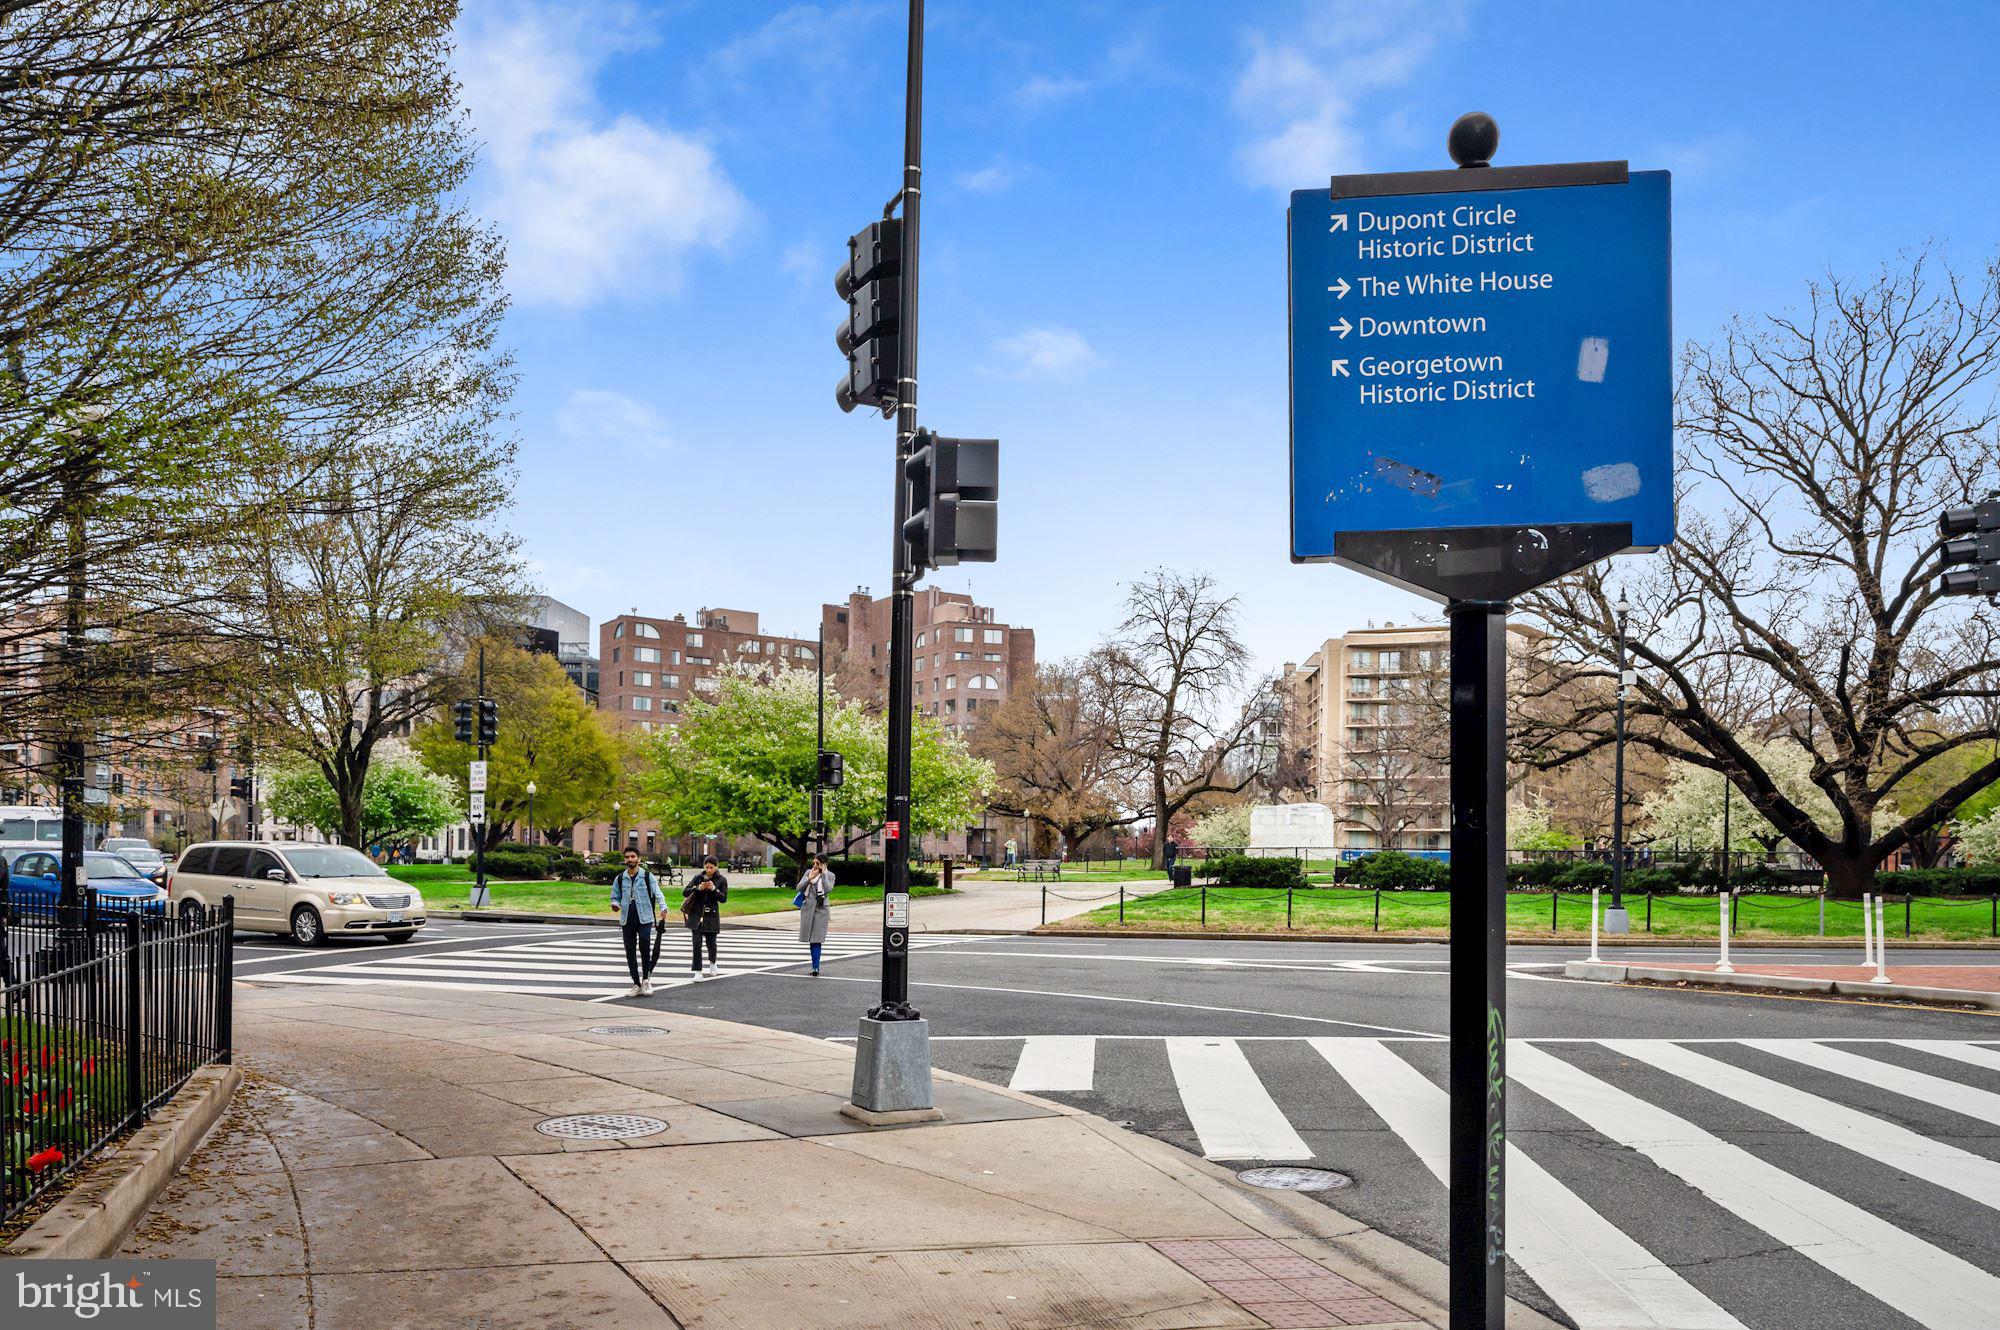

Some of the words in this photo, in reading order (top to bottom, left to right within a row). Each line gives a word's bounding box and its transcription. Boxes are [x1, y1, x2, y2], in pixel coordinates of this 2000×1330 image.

[1358, 210, 1446, 236] Dupont
[1452, 203, 1517, 227] Circle
[1358, 236, 1445, 260] Historic
[1452, 231, 1534, 255] District
[1357, 276, 1401, 298] The
[1405, 273, 1473, 295] White
[1480, 271, 1553, 292] House
[1359, 315, 1486, 338] Downtown
[1359, 354, 1503, 380] Georgetown
[1360, 381, 1447, 405] Historic
[1453, 378, 1536, 401] District
